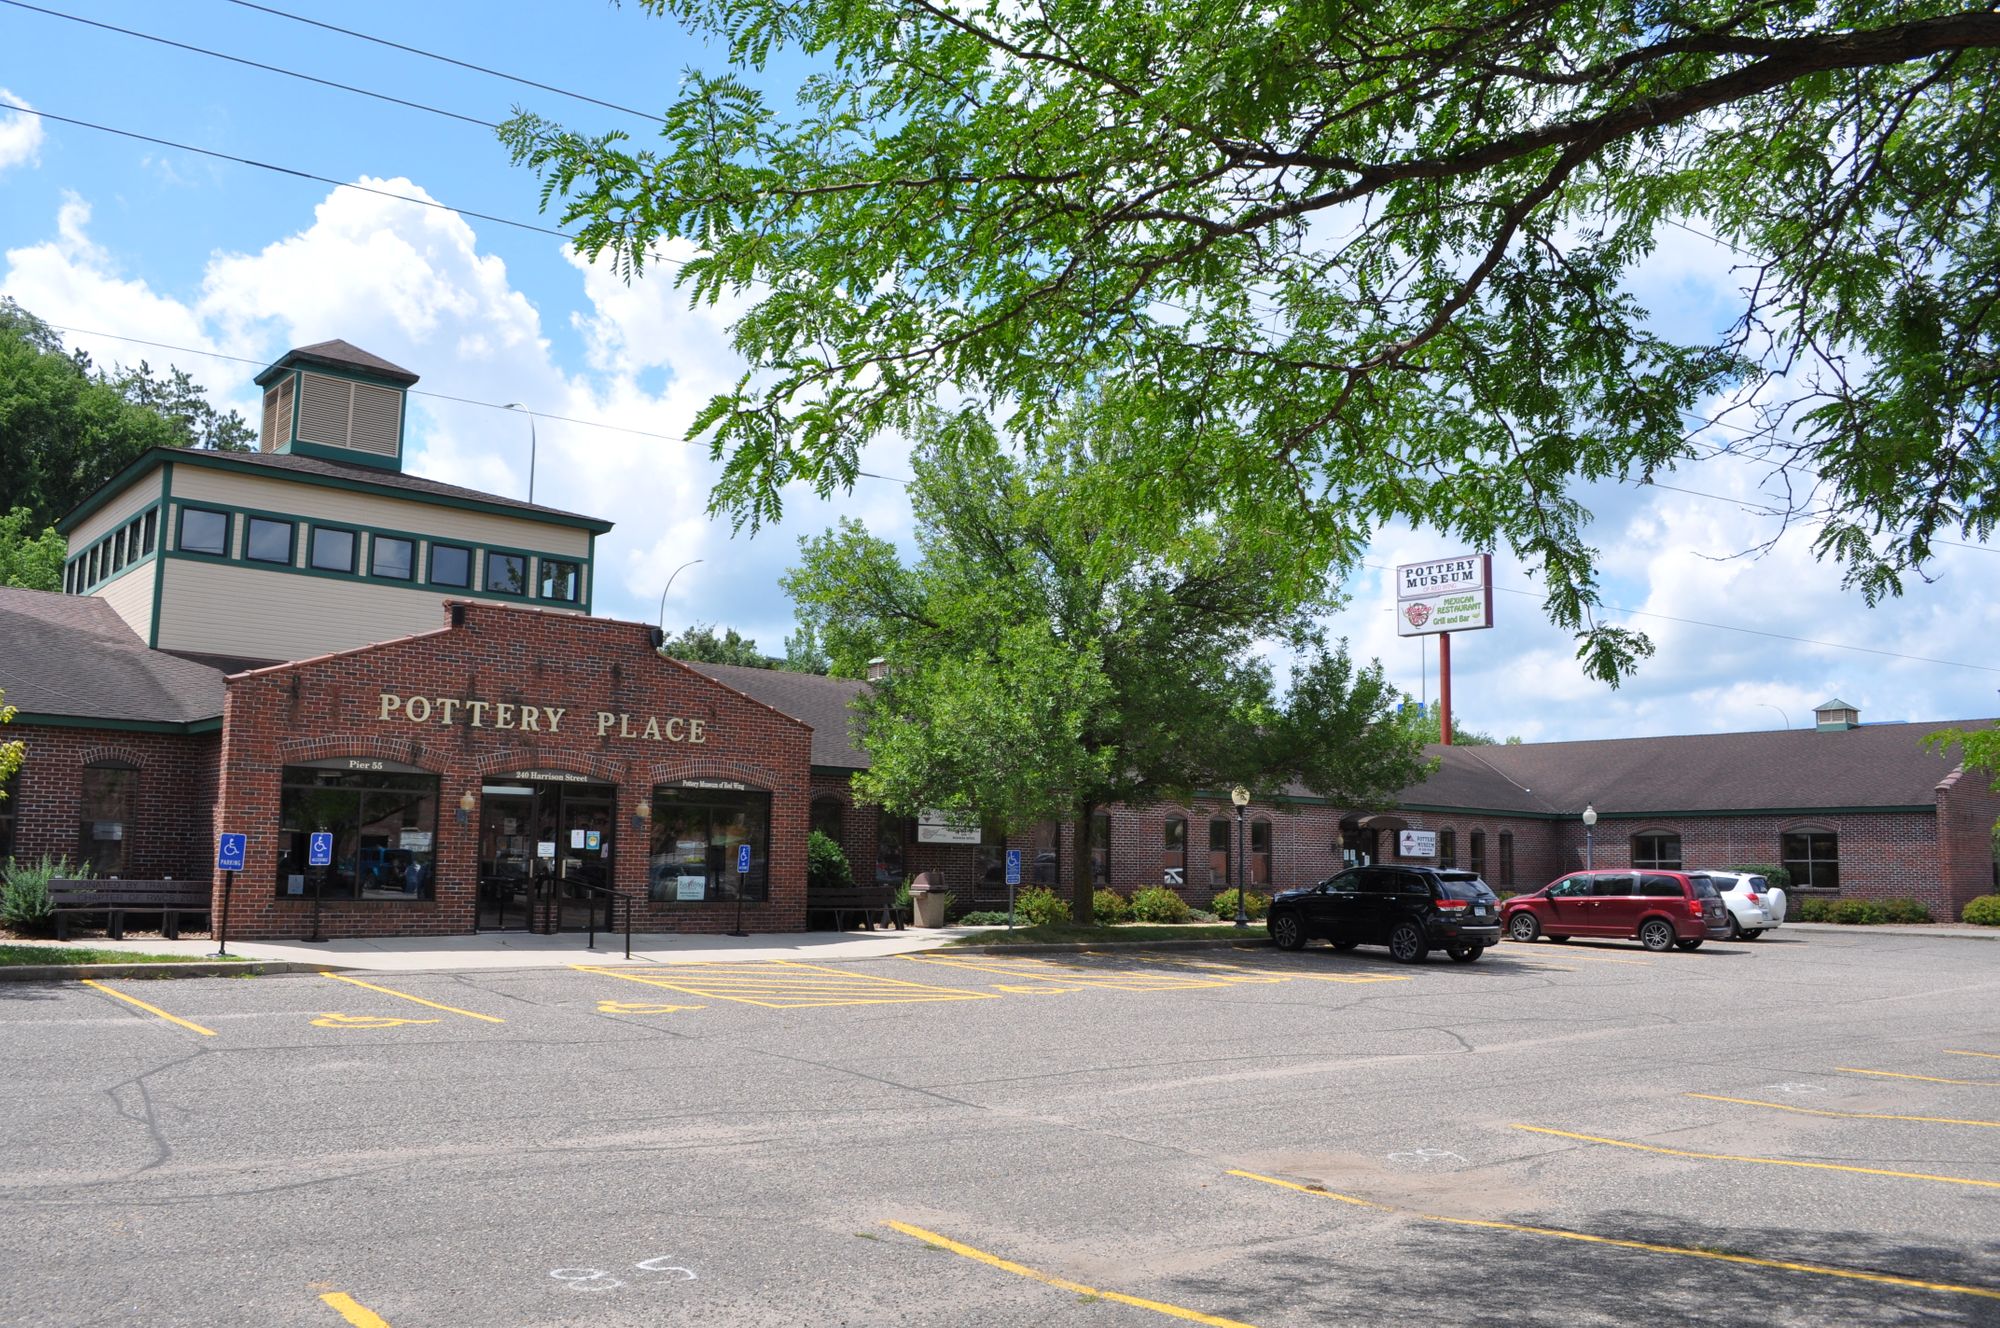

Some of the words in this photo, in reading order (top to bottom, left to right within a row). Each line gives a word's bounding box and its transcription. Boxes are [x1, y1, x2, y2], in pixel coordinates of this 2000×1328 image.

[1406, 560, 1475, 578] POTTERY
[1406, 570, 1474, 588] MUSEUM
[1444, 596, 1474, 605] MEXICAN
[1437, 603, 1481, 614] RESTAURANT
[1433, 616, 1446, 625] Grill
[1447, 616, 1458, 624] and
[1459, 614, 1470, 623] Bar
[378, 694, 566, 732] POTTERY
[596, 711, 706, 743] PLACE
[349, 759, 370, 769] Pier
[371, 761, 383, 770] 55
[515, 771, 529, 779] 240
[530, 771, 564, 781] Harrison
[565, 773, 588, 782] Street
[682, 780, 699, 788] Pottery
[699, 780, 719, 789] Museum
[733, 782, 745, 791] Wing
[74, 881, 121, 889] DONATED
[126, 881, 138, 889] BY
